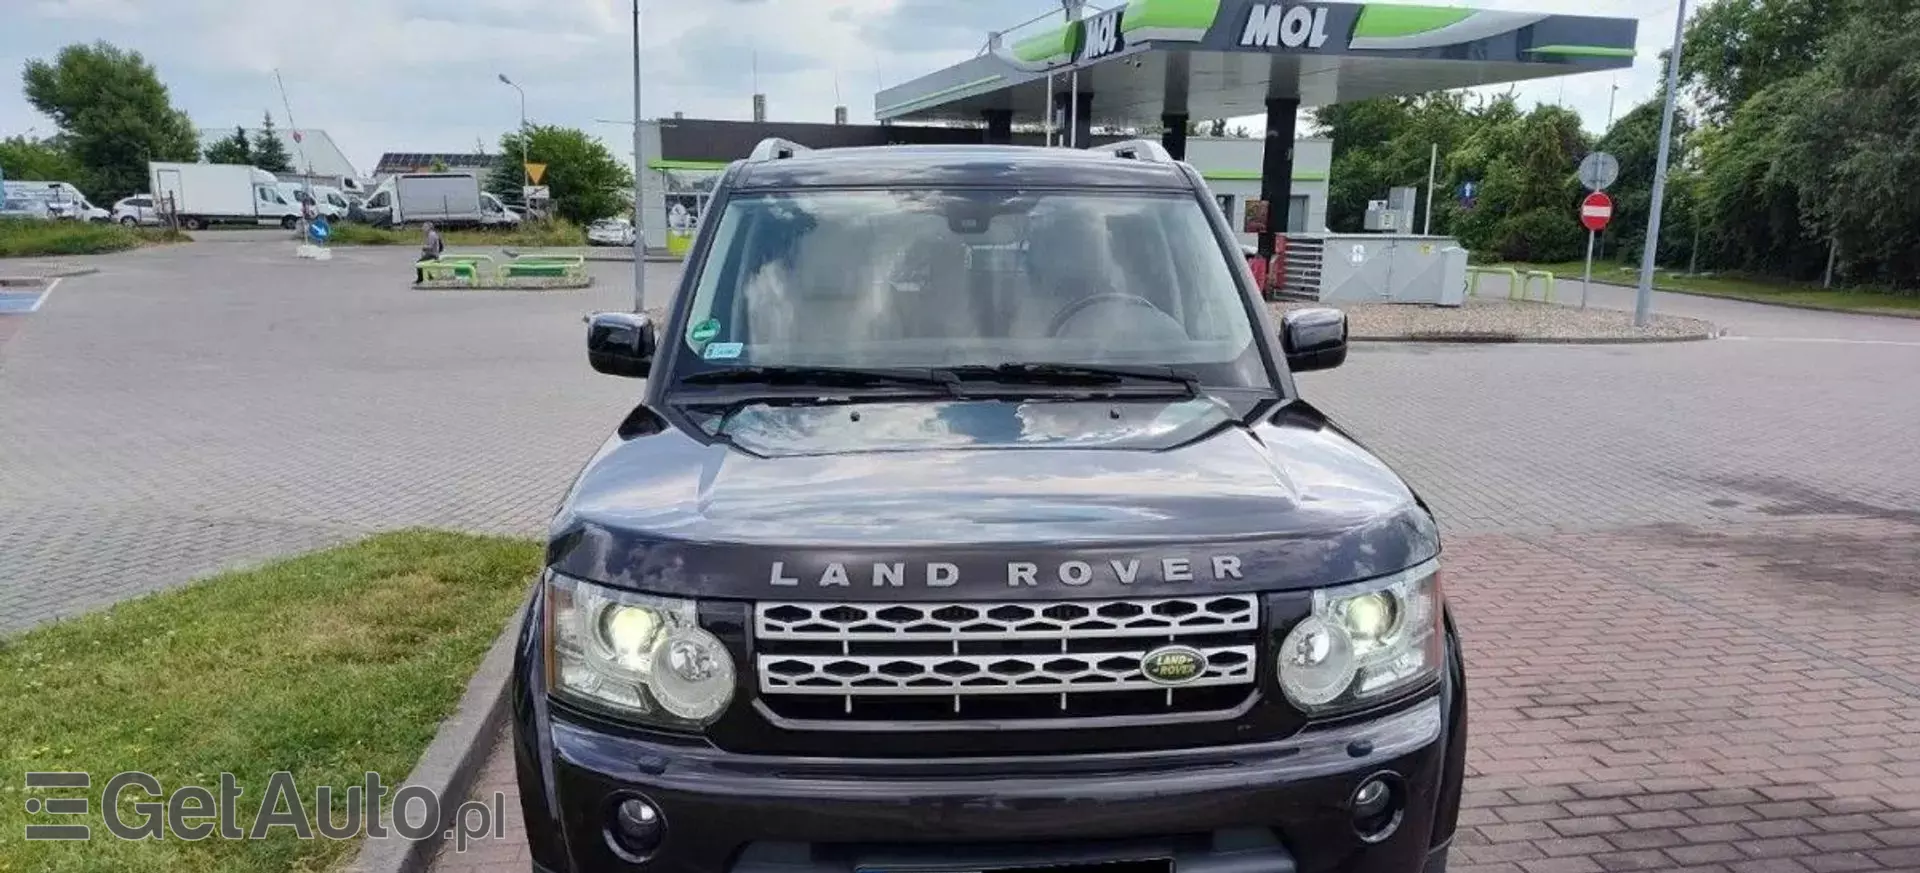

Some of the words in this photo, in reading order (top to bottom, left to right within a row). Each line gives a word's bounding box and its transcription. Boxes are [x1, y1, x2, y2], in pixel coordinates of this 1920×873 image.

[1085, 10, 1119, 59] MOL
[1241, 5, 1329, 49] MOL
[769, 562, 960, 588] LAND
[1007, 555, 1245, 587] ROVER
